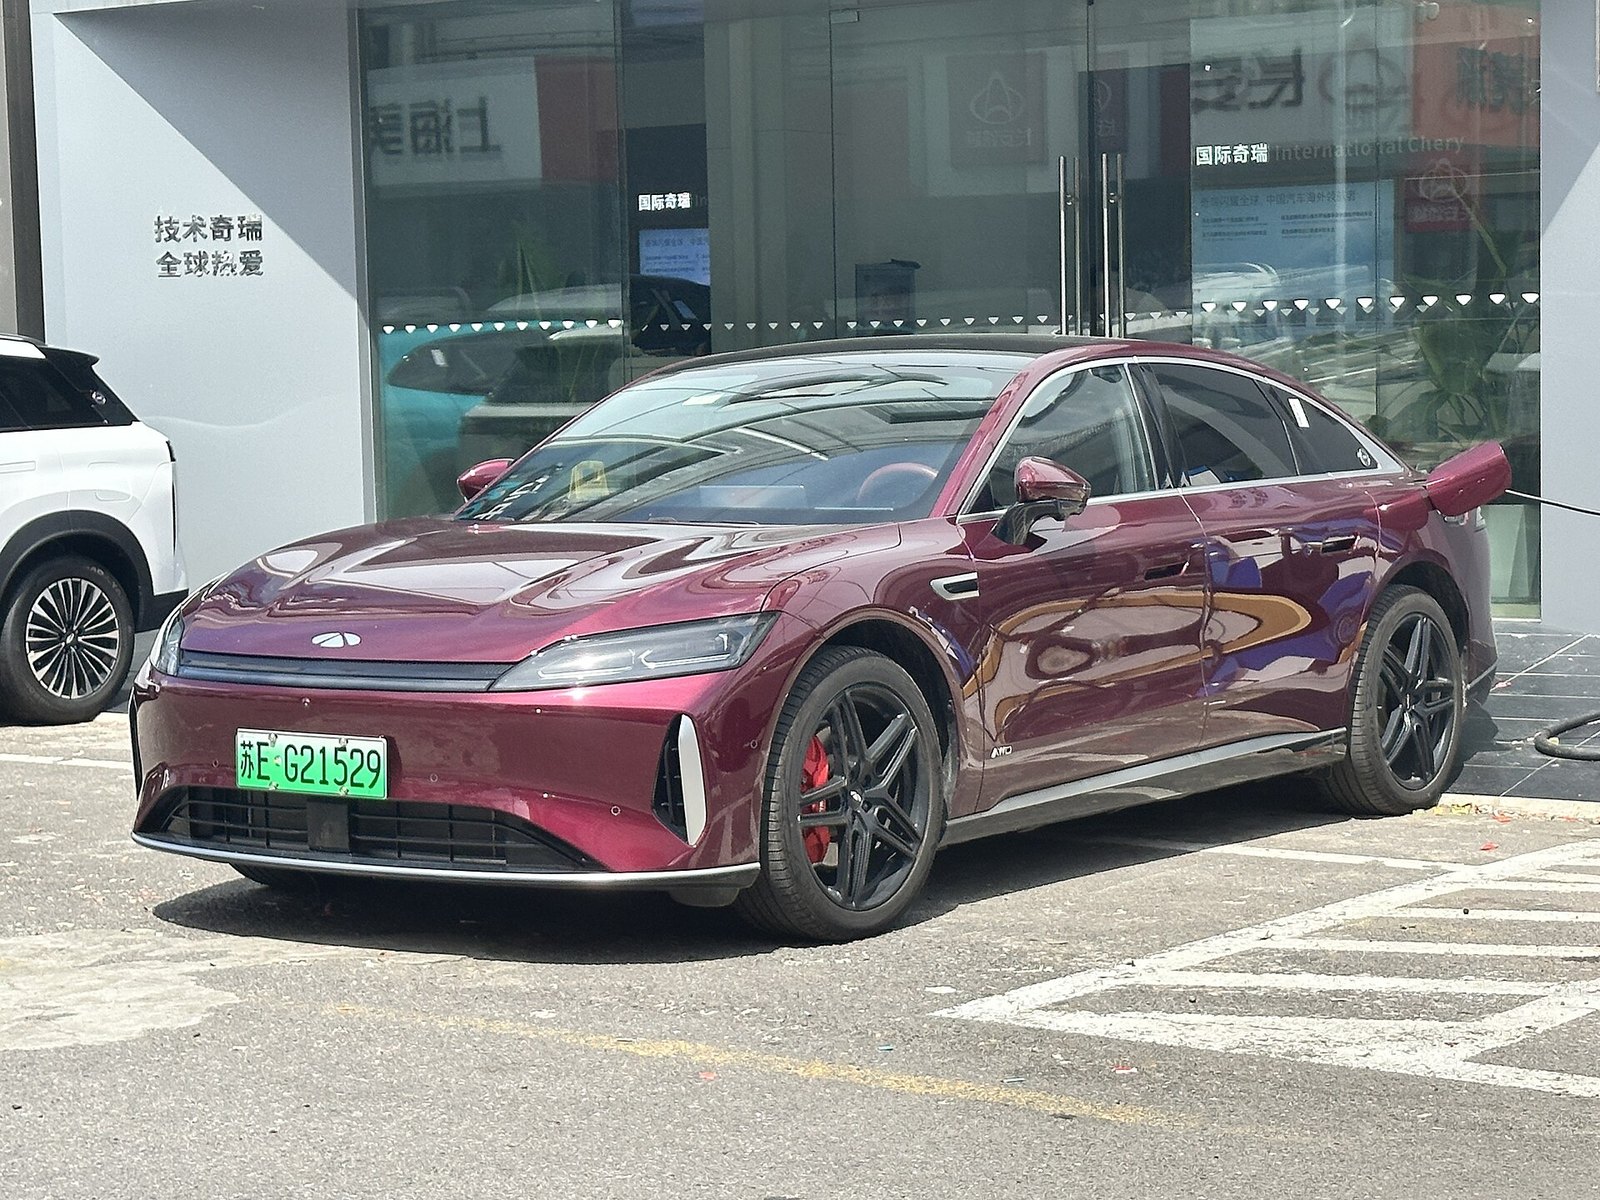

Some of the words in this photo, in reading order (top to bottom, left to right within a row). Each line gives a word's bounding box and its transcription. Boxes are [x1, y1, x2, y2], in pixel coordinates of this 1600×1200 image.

[1196, 143, 1268, 165] 国际奇瑞
[1407, 136, 1464, 154] Chery
[638, 192, 691, 211] 国际奇瑞
[154, 215, 262, 242] 技术奇瑞
[156, 250, 263, 277] 全球热爱
